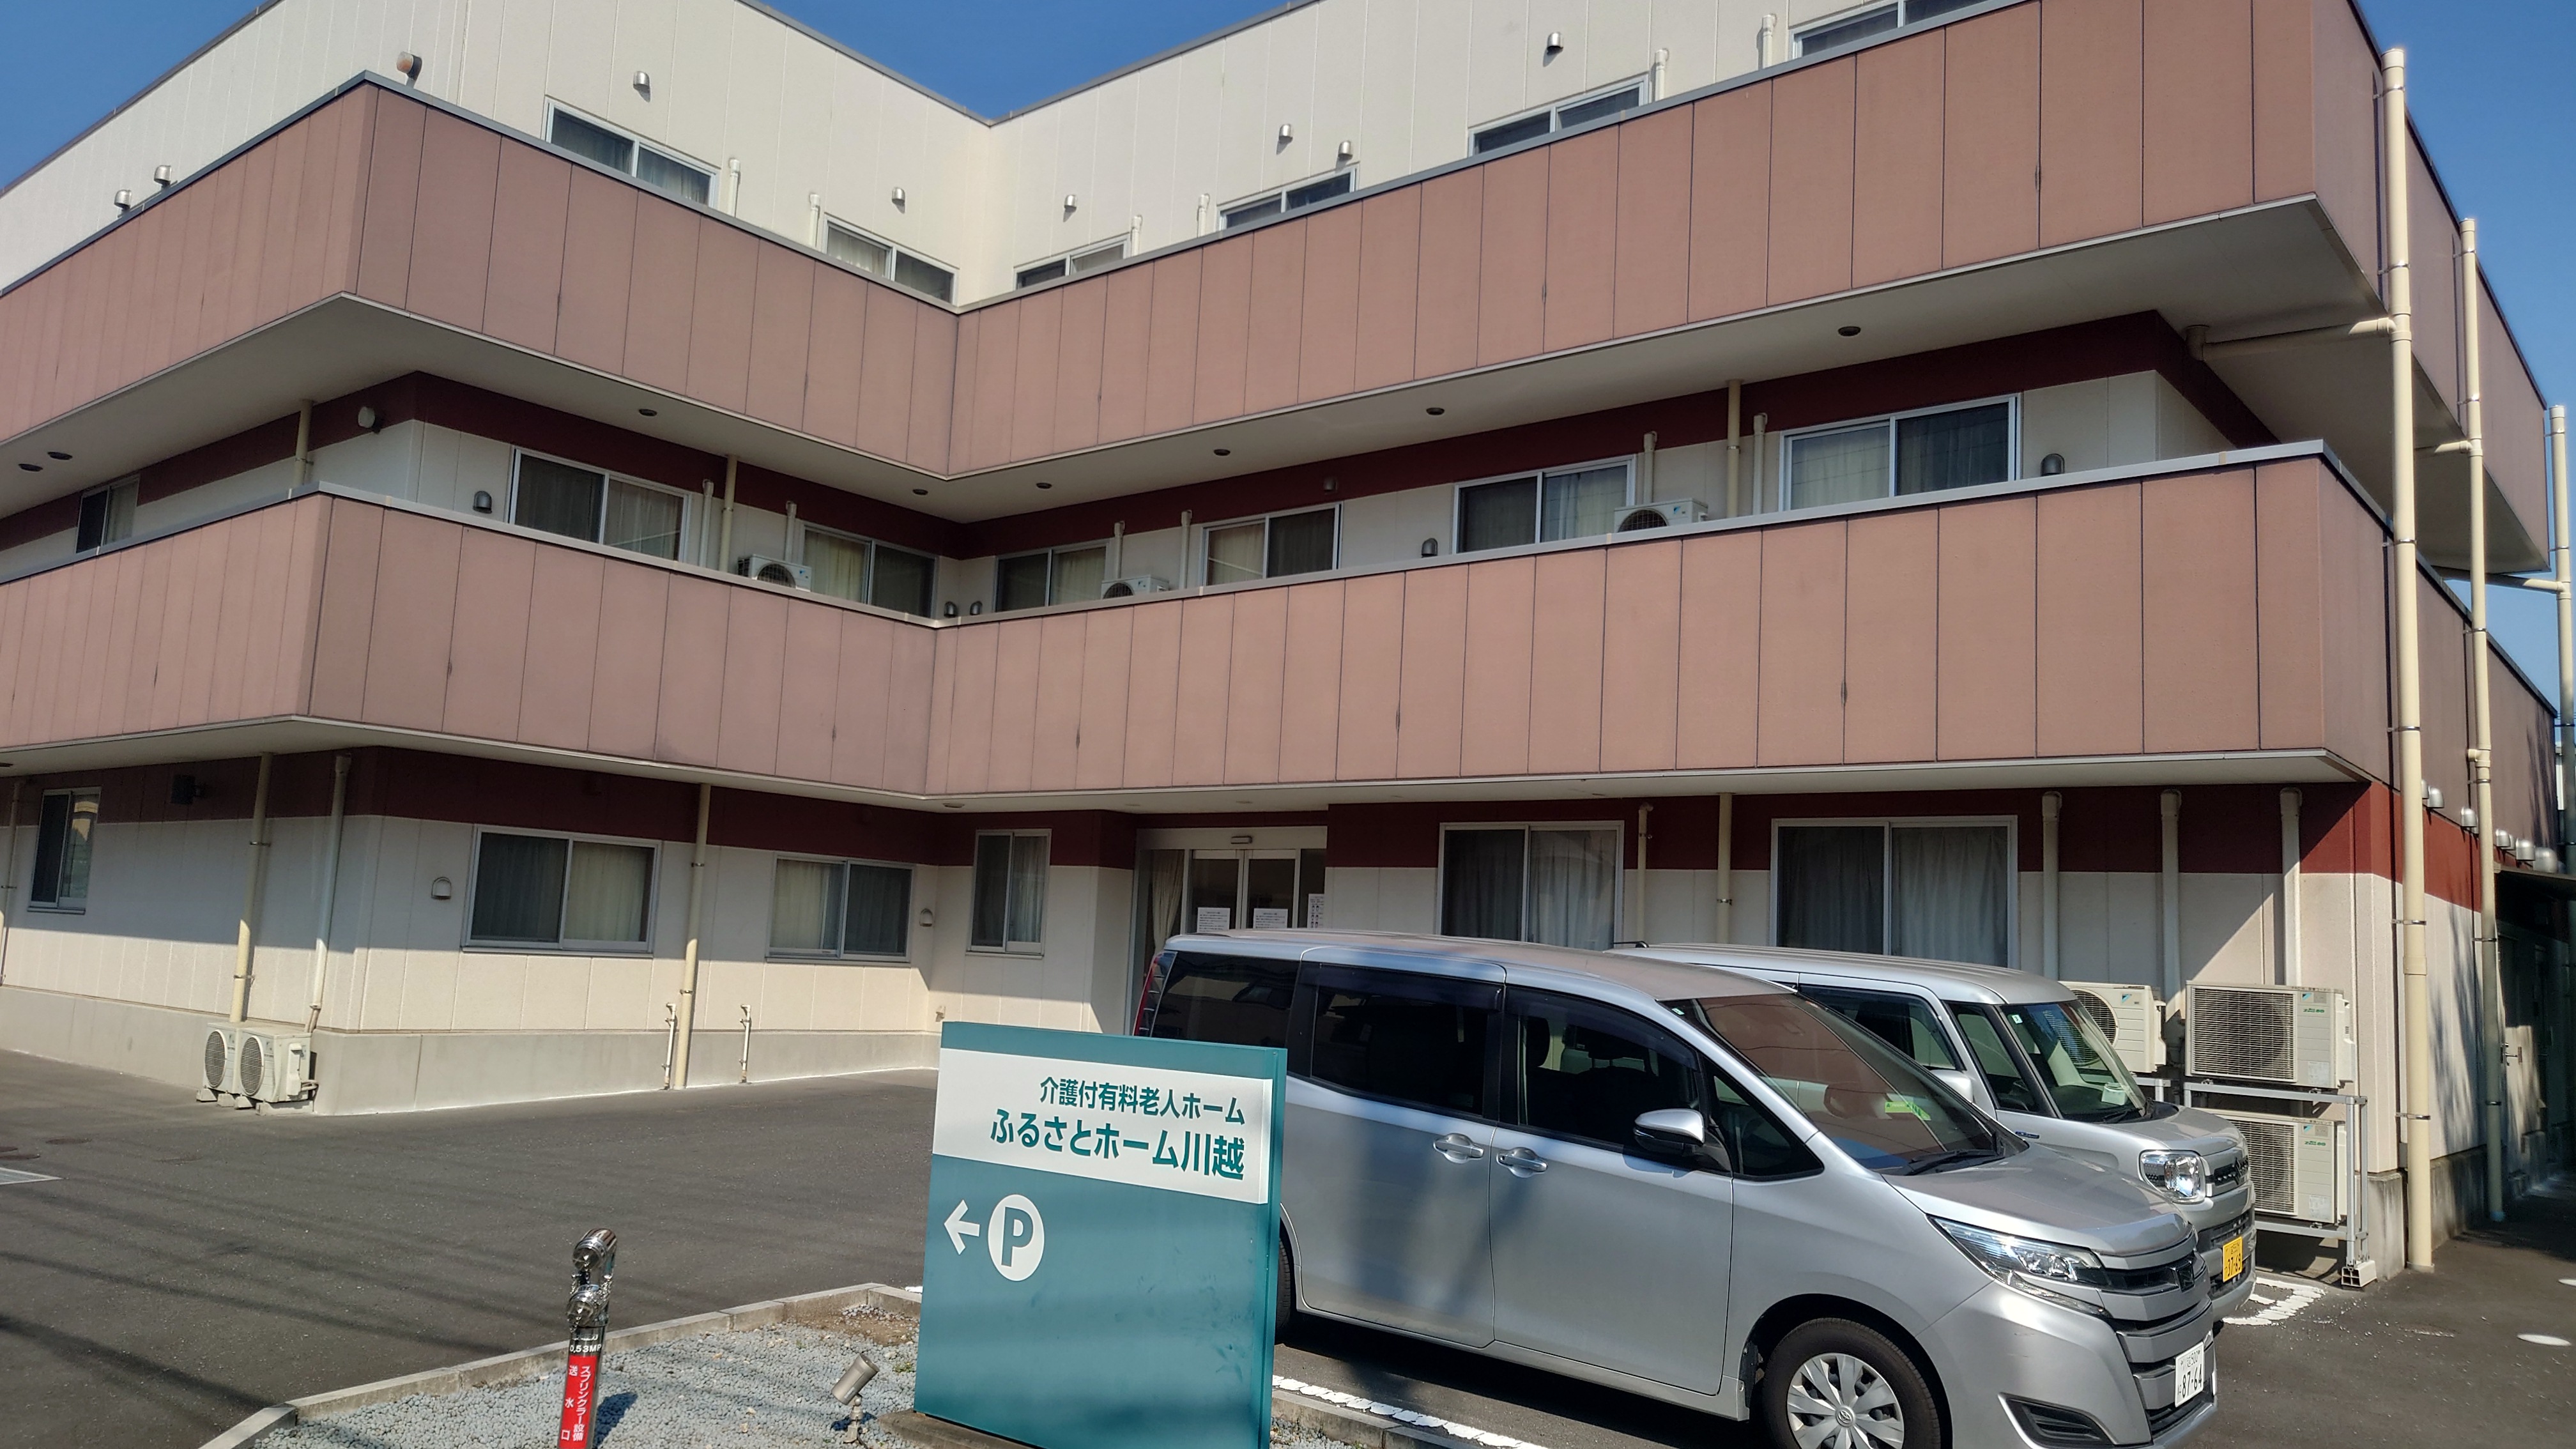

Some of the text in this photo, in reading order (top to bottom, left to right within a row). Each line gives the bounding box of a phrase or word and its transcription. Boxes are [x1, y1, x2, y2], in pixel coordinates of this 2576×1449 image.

[1039, 1076, 1245, 1125] 介護付有料老人ホーム
[990, 1108, 1245, 1180] ふるさとホーム川越
[1000, 1206, 1034, 1267] P
[2227, 1253, 2241, 1276] 37-69
[561, 1365, 578, 1441] 送水口
[572, 1365, 592, 1441] スプリンクラー設備
[2182, 1363, 2202, 1399] 87-64
